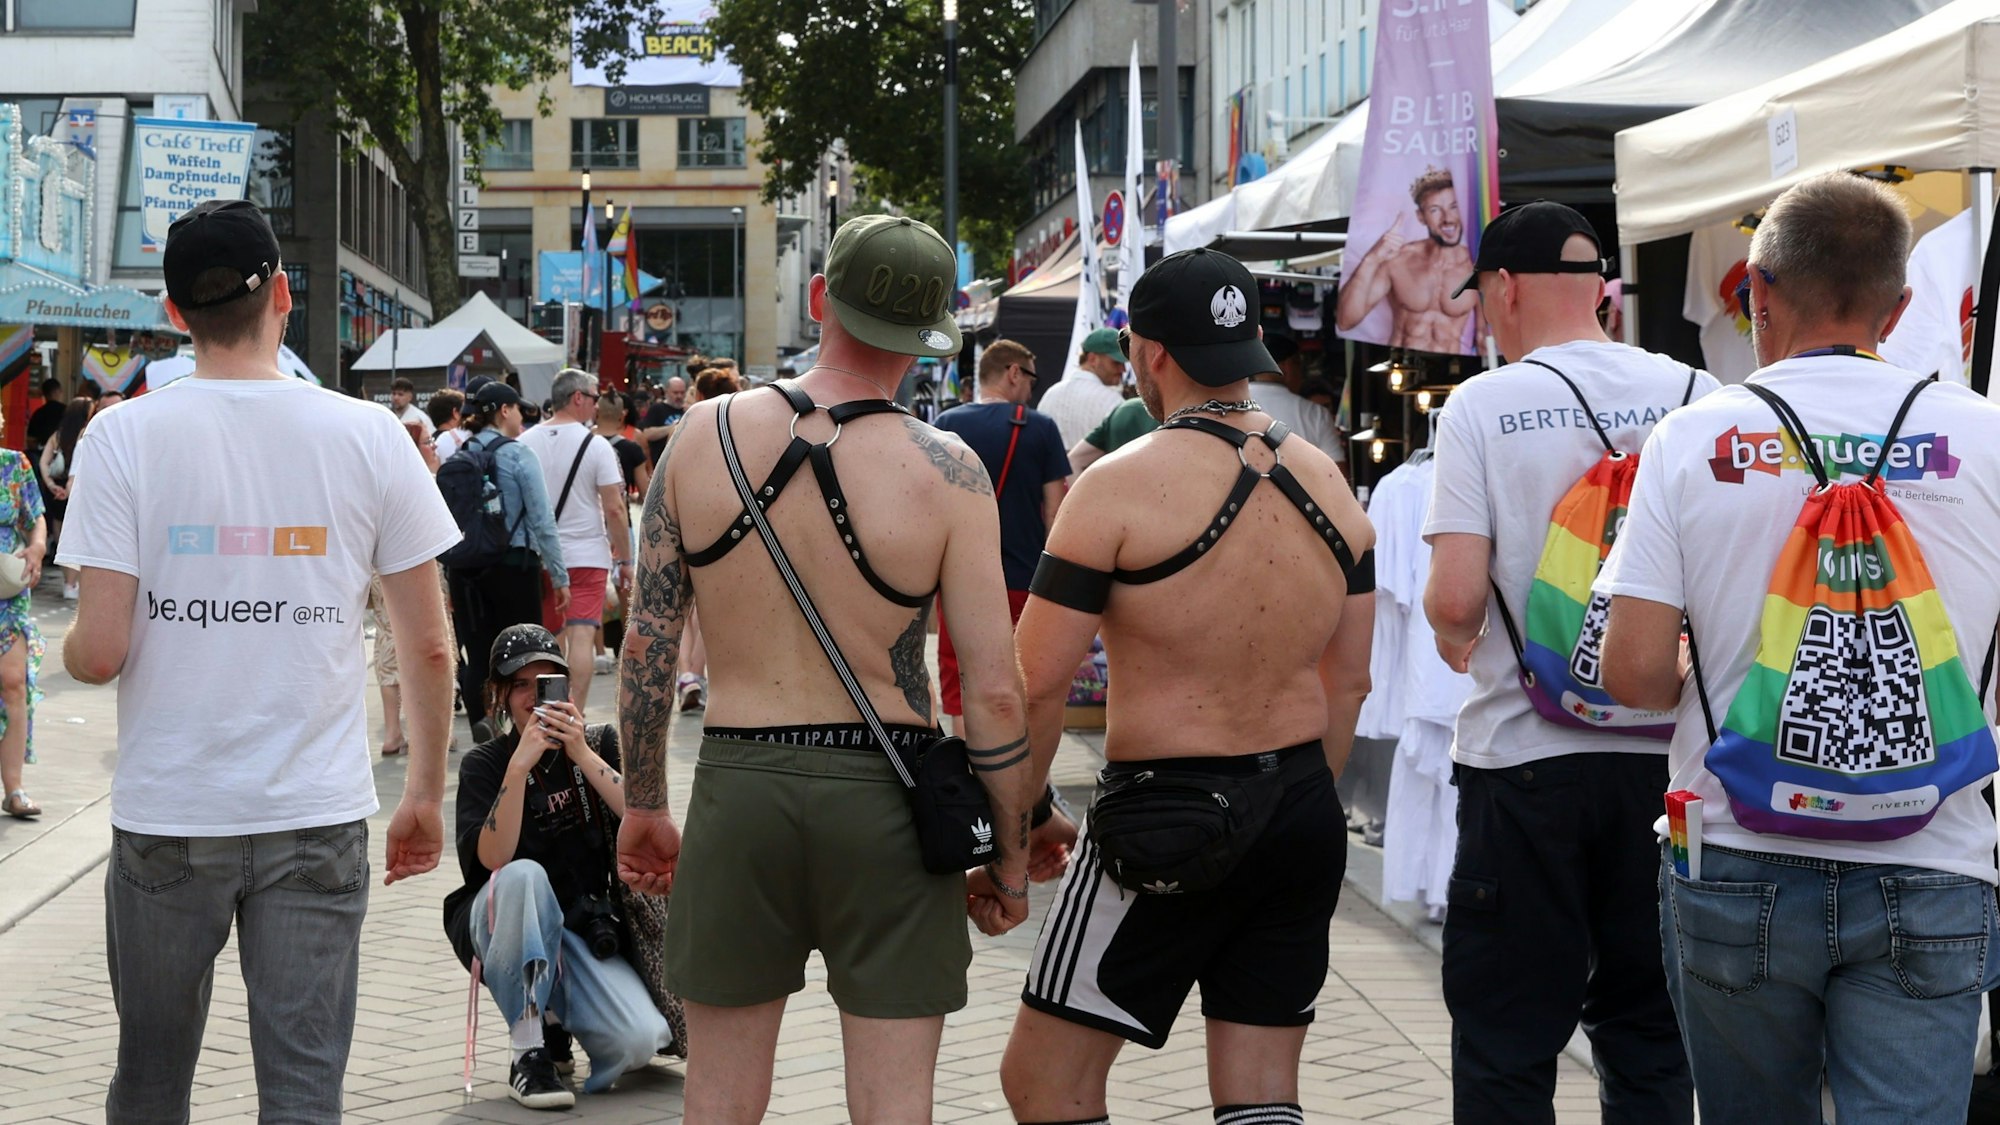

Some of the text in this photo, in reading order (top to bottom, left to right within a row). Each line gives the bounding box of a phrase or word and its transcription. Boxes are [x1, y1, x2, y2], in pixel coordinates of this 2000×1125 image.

[629, 93, 704, 104] HOLMES PLACE
[1390, 91, 1475, 126] BLEIB
[145, 133, 244, 153] Café Treff
[1382, 126, 1479, 156] SAUBER
[1775, 120, 1791, 147] G23
[167, 153, 221, 169] Waffeln
[144, 167, 241, 185] Dampfnudeln
[168, 183, 217, 199] Crêpes
[144, 196, 198, 211] Pfannk
[865, 264, 944, 318] 020
[26, 299, 131, 320] Pfannkuchen
[1730, 434, 1932, 470] be.queer
[1892, 489, 1902, 498] at
[1905, 490, 1964, 505] Bertelsmann
[148, 591, 345, 629] be.queer @RTL
[572, 765, 584, 785] EOS
[578, 786, 592, 823] DIGITAL
[972, 843, 993, 855] adidas
